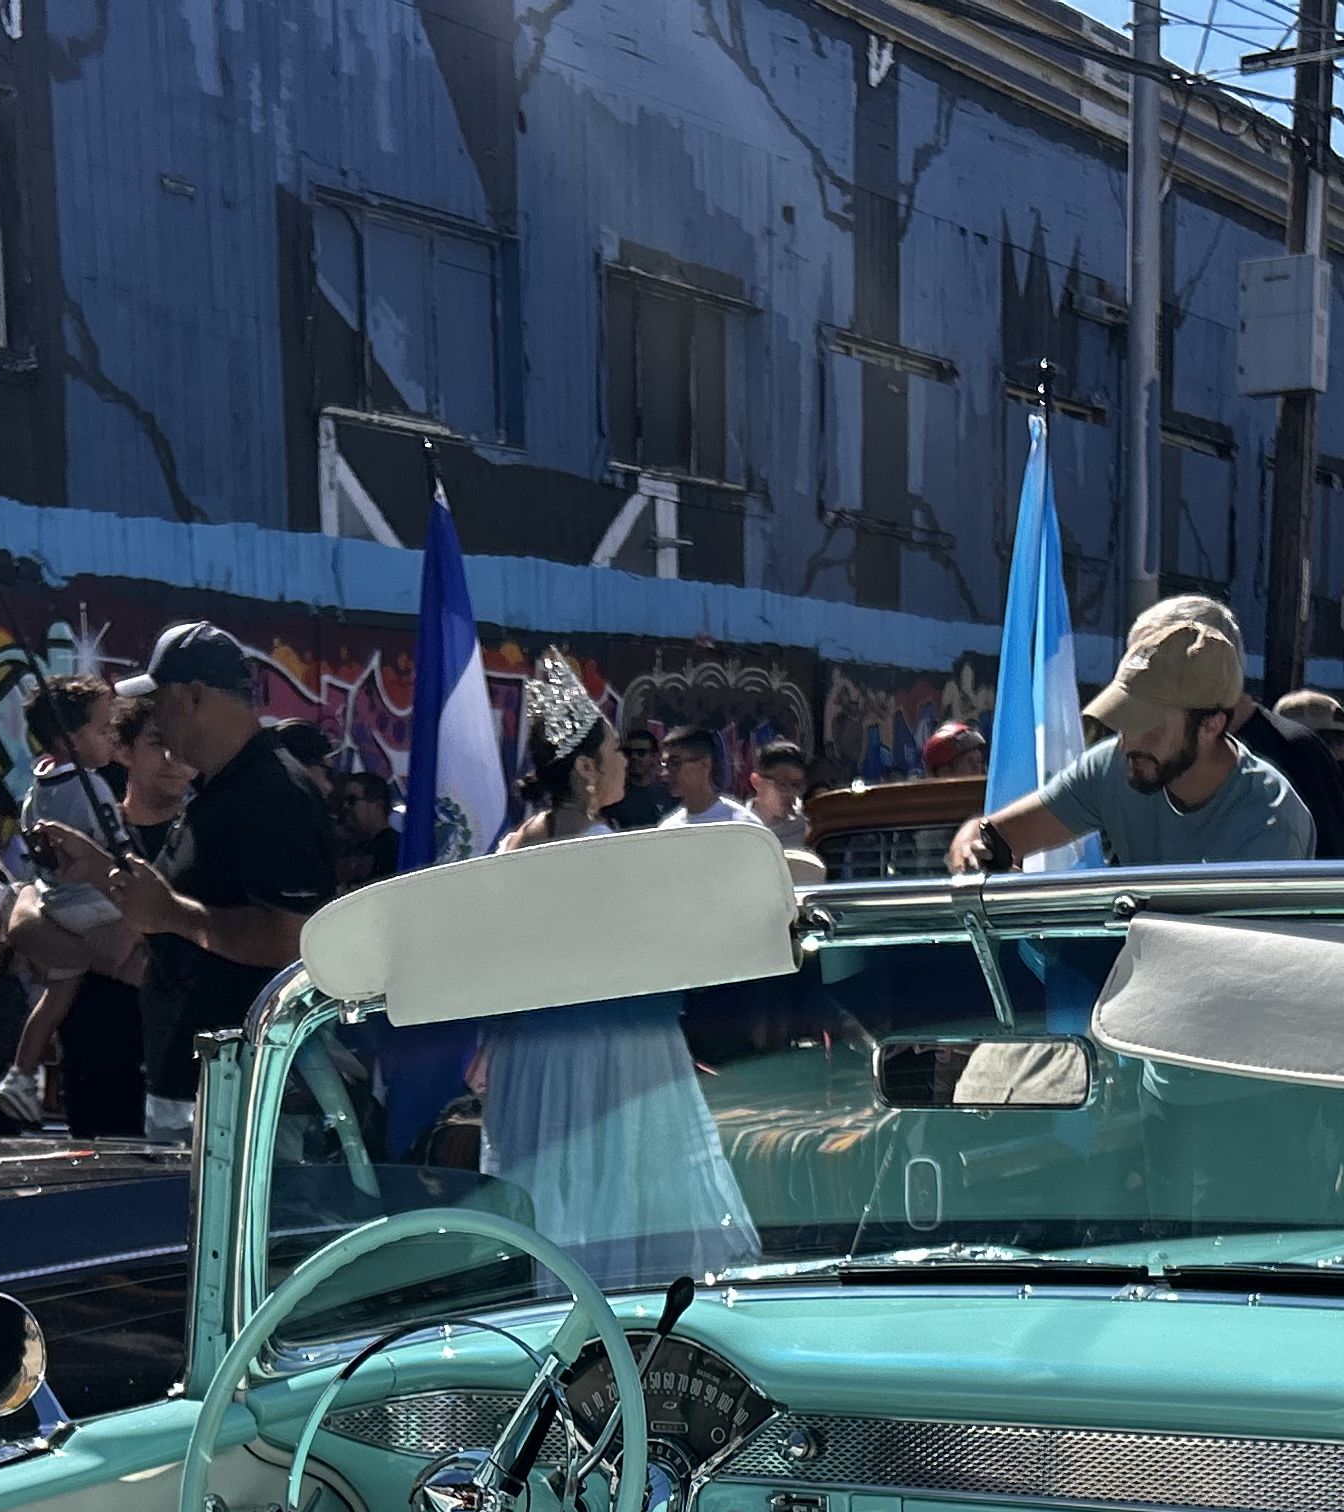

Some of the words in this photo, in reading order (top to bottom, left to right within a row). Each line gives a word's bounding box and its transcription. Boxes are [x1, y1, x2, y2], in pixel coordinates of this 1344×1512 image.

[649, 1371, 661, 1390] 50
[663, 1371, 675, 1390] 60
[677, 1372, 689, 1393] 70
[689, 1377, 703, 1397] 80
[703, 1384, 717, 1403] 90
[716, 1392, 735, 1414] 100
